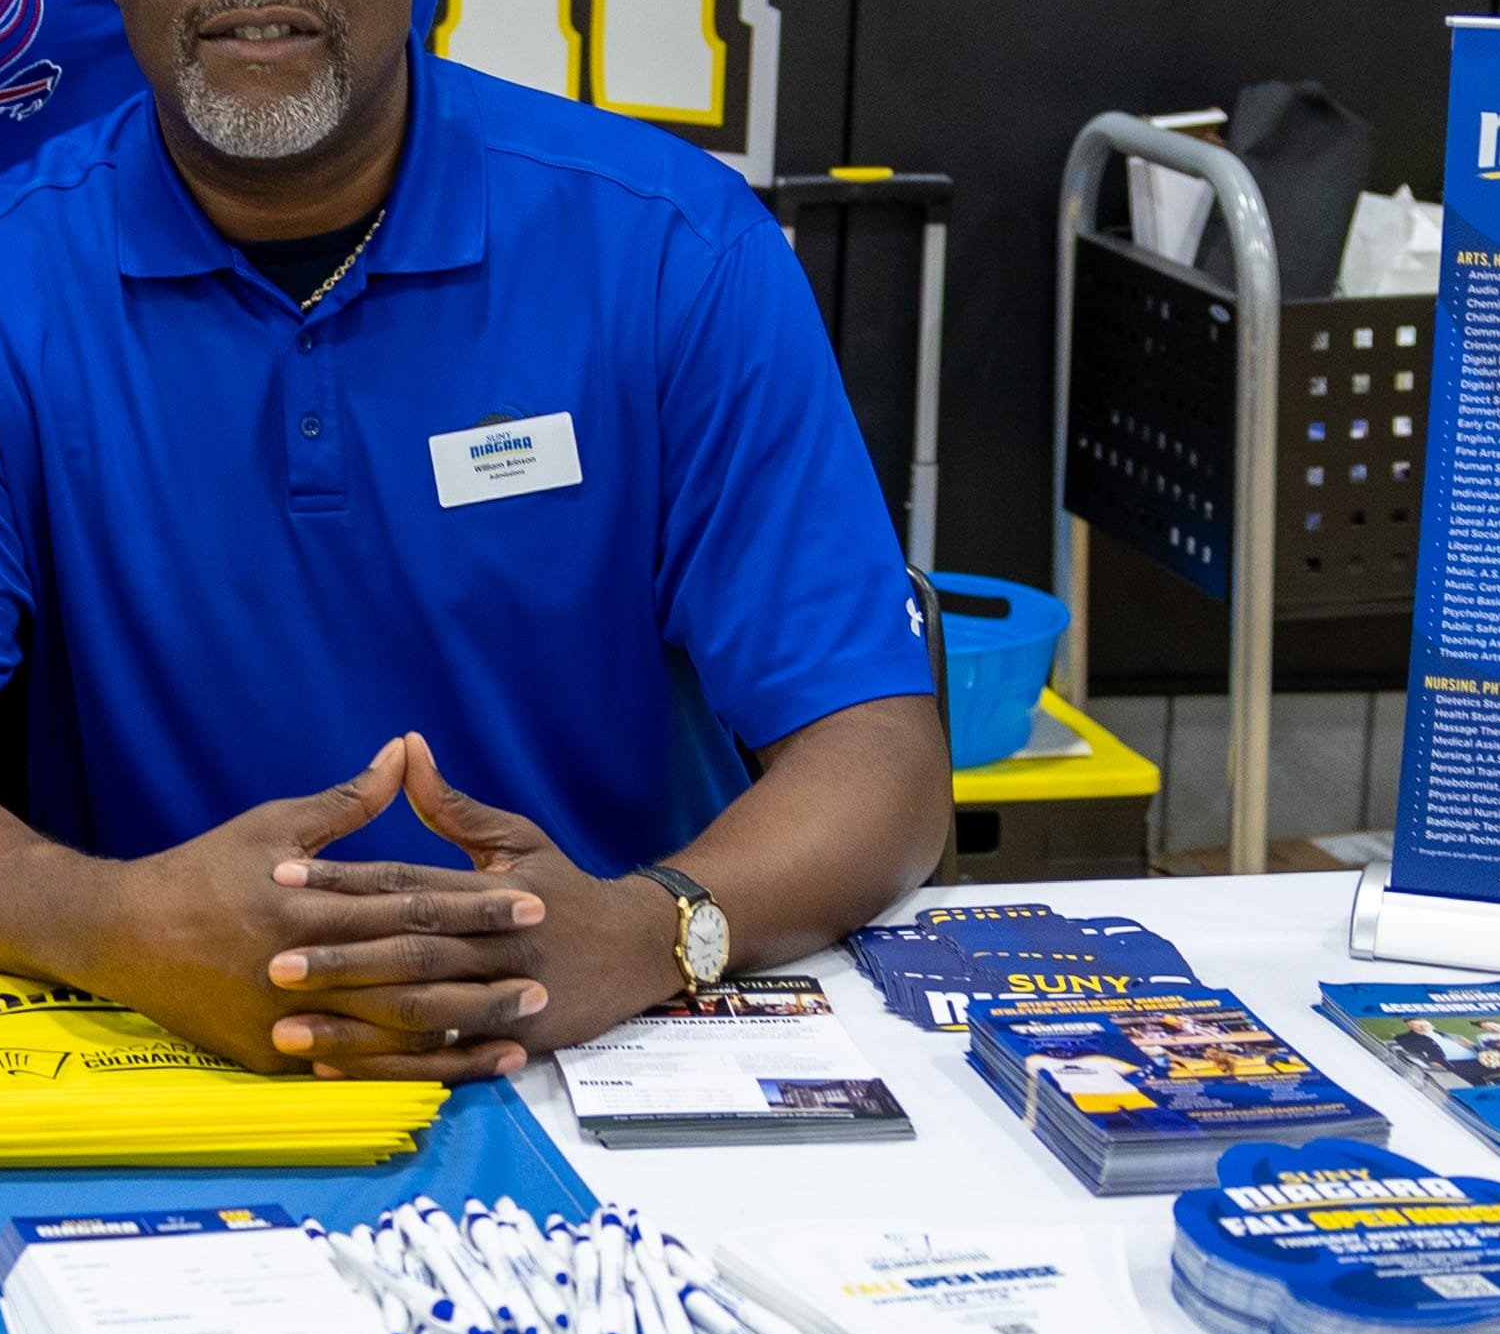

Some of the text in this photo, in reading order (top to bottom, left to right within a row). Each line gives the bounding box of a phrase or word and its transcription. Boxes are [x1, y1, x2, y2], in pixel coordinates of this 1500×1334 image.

[1457, 251, 1491, 268] ARTS,
[470, 436, 532, 459] NIAGARA
[1424, 675, 1480, 695] NURSING,
[1430, 762, 1476, 776] Personal
[739, 980, 812, 990] VILLAGE
[1007, 973, 1130, 994] SUNY
[85, 1052, 190, 1069] CULINARY
[1278, 1168, 1371, 1184] SUNY
[1224, 1177, 1467, 1210] NIAGARA
[1219, 1213, 1316, 1236] FALL
[1308, 1208, 1411, 1230] OPEN
